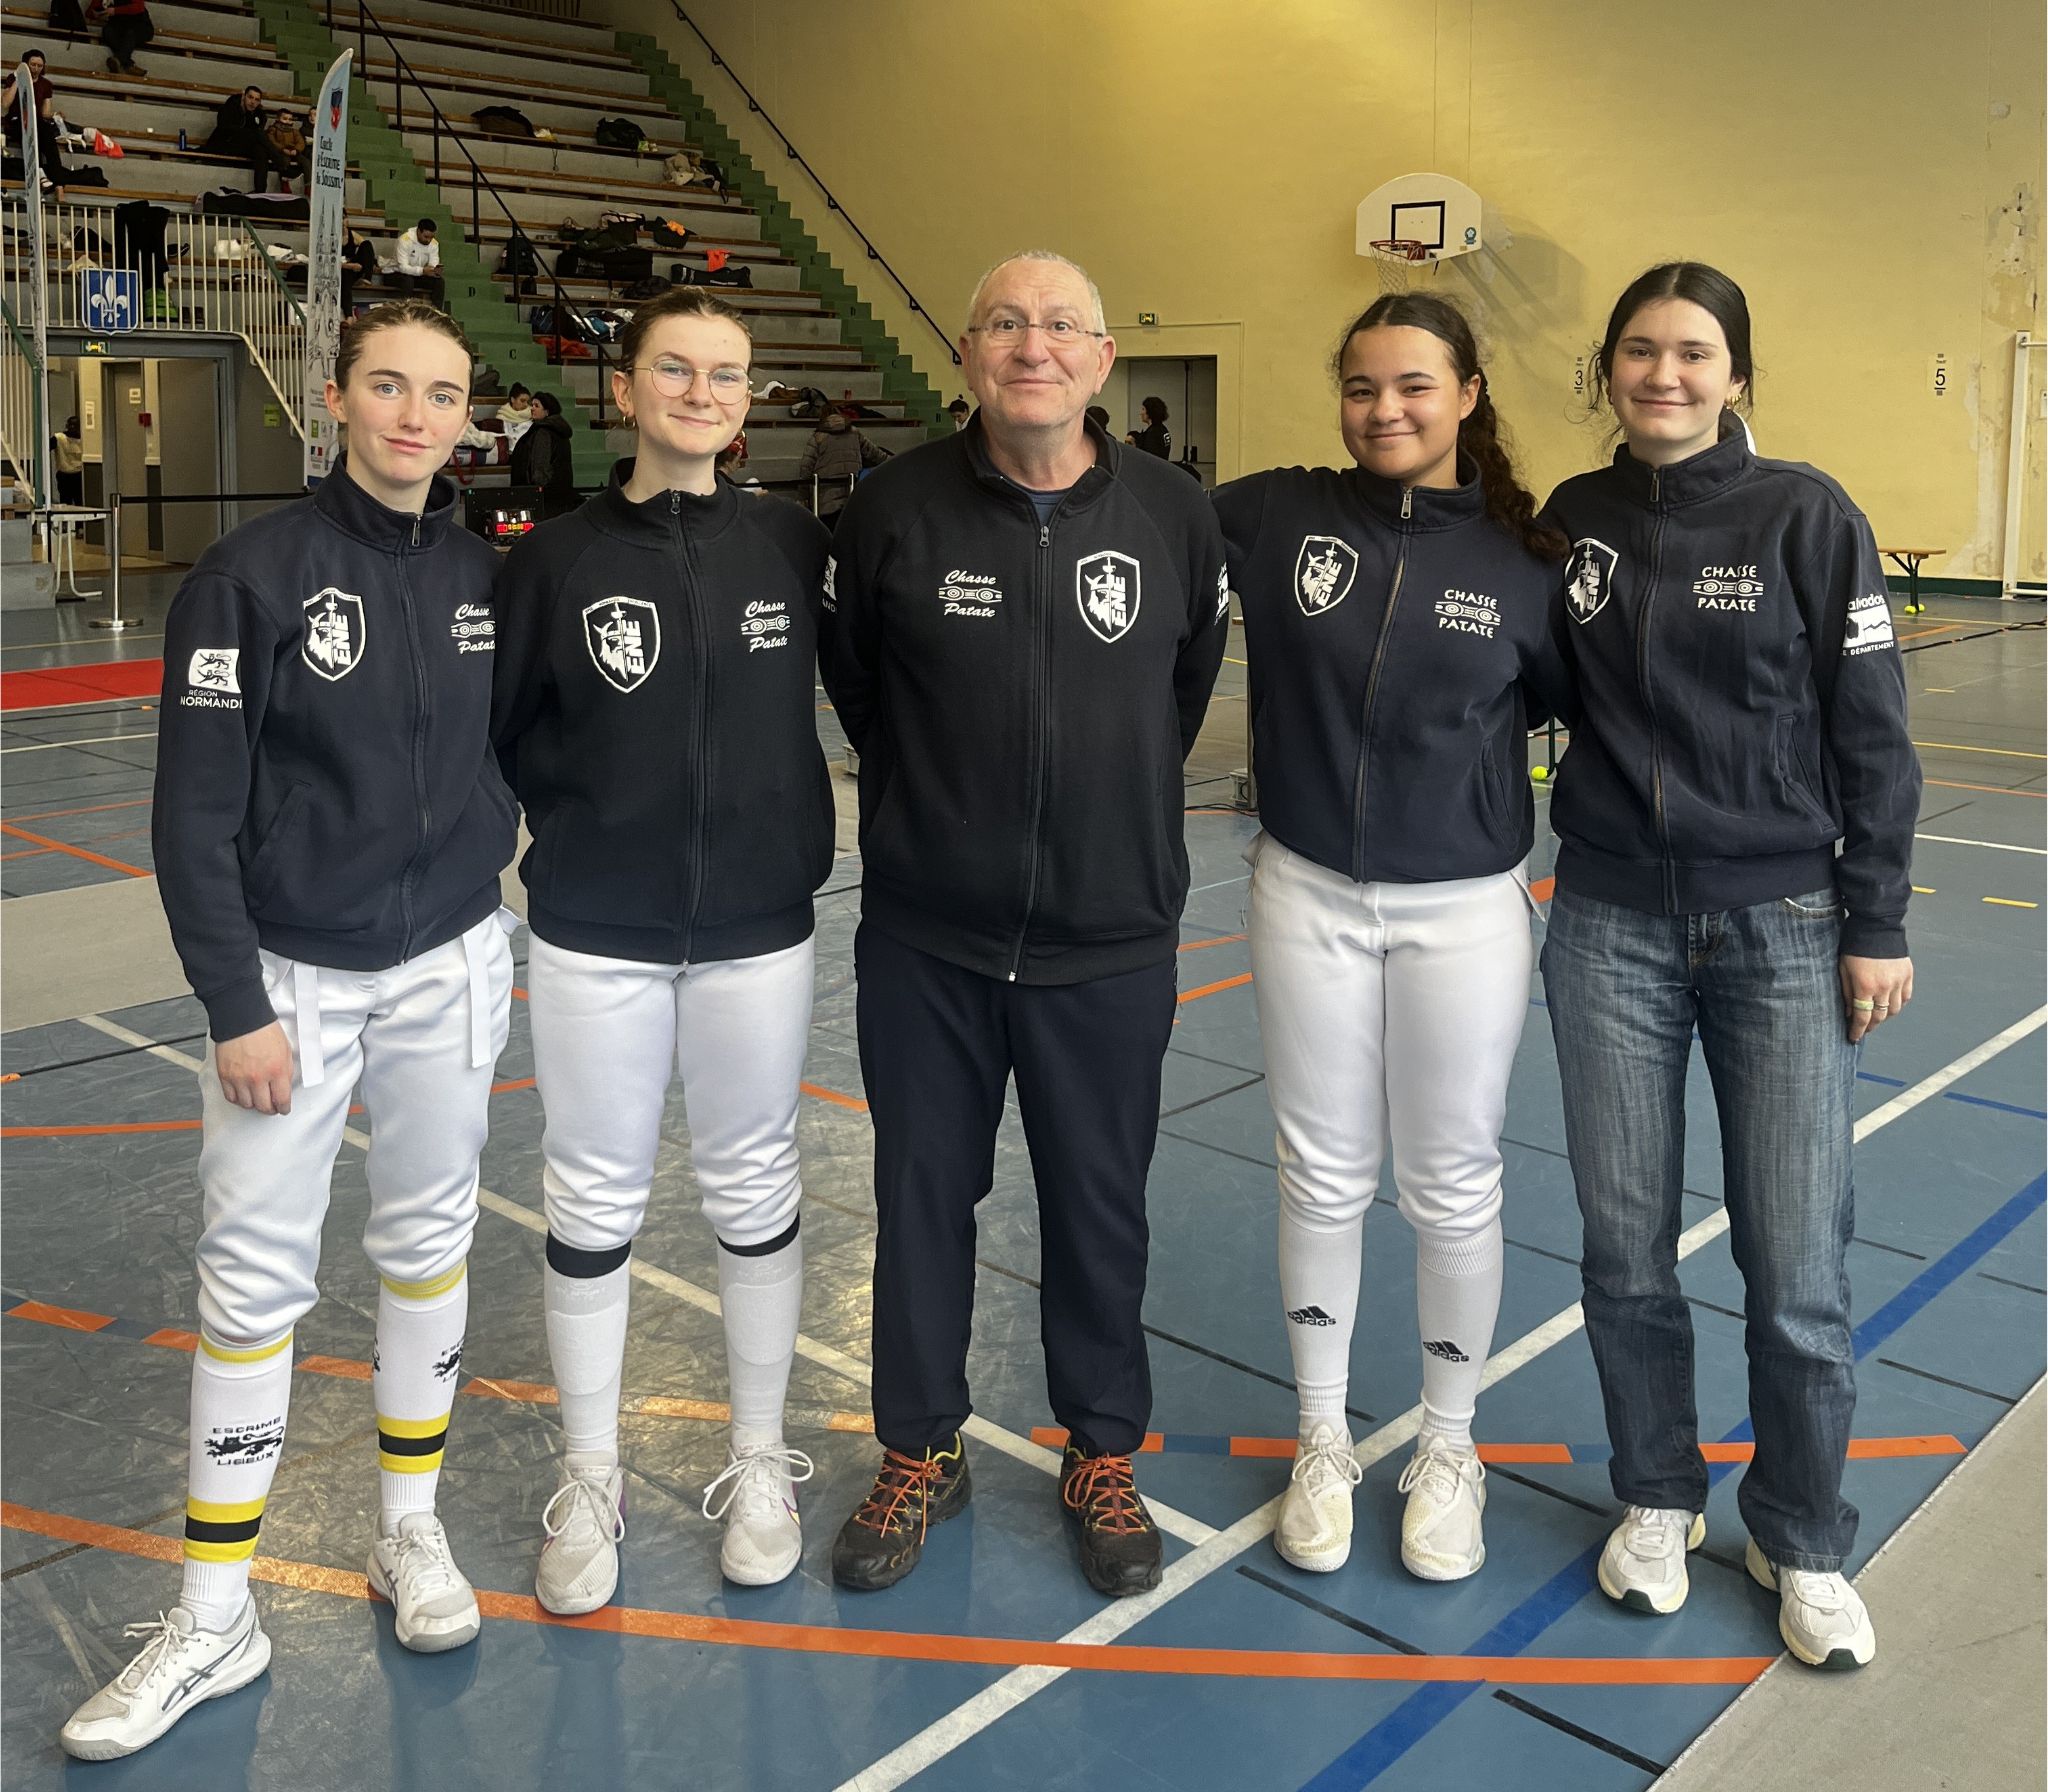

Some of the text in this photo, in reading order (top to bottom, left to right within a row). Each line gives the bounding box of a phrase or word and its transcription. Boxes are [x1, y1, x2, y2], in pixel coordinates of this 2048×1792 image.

[352, 115, 360, 125] G
[467, 286, 476, 297] D
[509, 349, 517, 360] C
[1574, 370, 1583, 386] 3
[1935, 368, 1946, 386] 5
[944, 569, 997, 585] Chasse
[1701, 564, 1757, 578] CHASSE
[1314, 558, 1343, 607] ENE
[1110, 573, 1127, 628] ENE
[1444, 589, 1498, 610] CHASSE
[1697, 597, 1756, 612] PATATE
[744, 600, 786, 618] Chasse
[943, 602, 996, 617] Patate
[1438, 617, 1494, 639] PATATE
[331, 612, 352, 666] ENE
[457, 639, 496, 655] Patat
[621, 619, 646, 674] ENE
[749, 636, 788, 653] Patate
[188, 689, 218, 697] RÉGION
[1287, 1310, 1337, 1327] adidas
[1423, 1342, 1470, 1362] adidas
[212, 1415, 282, 1434] ESCRIME
